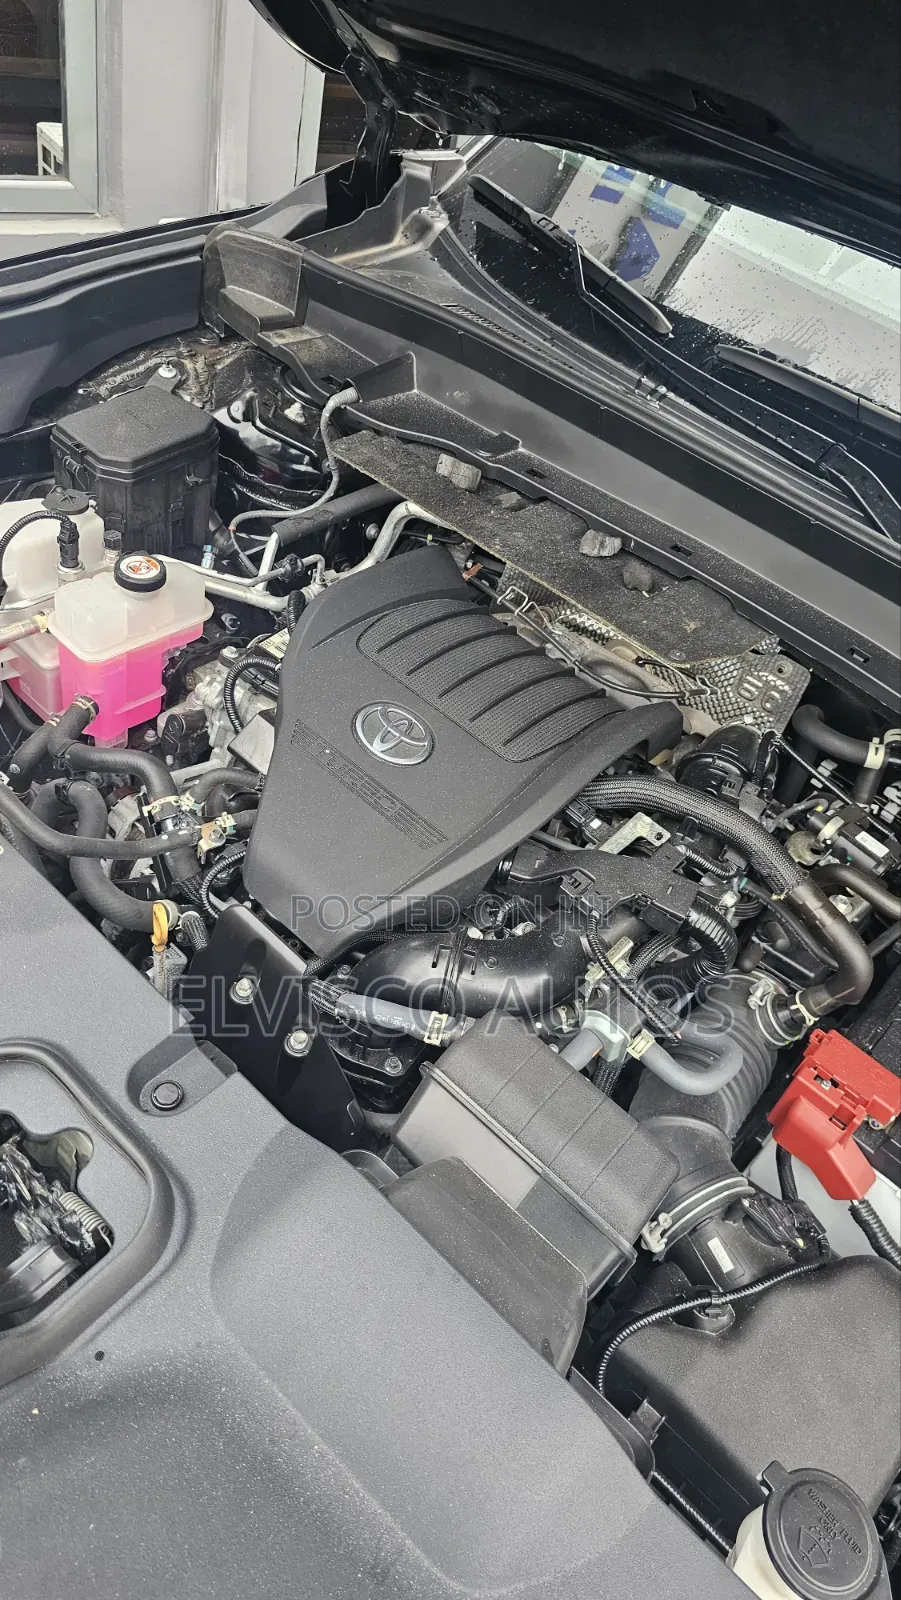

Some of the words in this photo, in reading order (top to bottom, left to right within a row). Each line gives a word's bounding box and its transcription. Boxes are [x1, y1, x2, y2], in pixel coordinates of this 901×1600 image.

[316, 742, 397, 813] TURBO
[808, 1488, 840, 1528] WASHER
[839, 1527, 862, 1556] FLUID
[819, 1517, 841, 1540] ONLY
